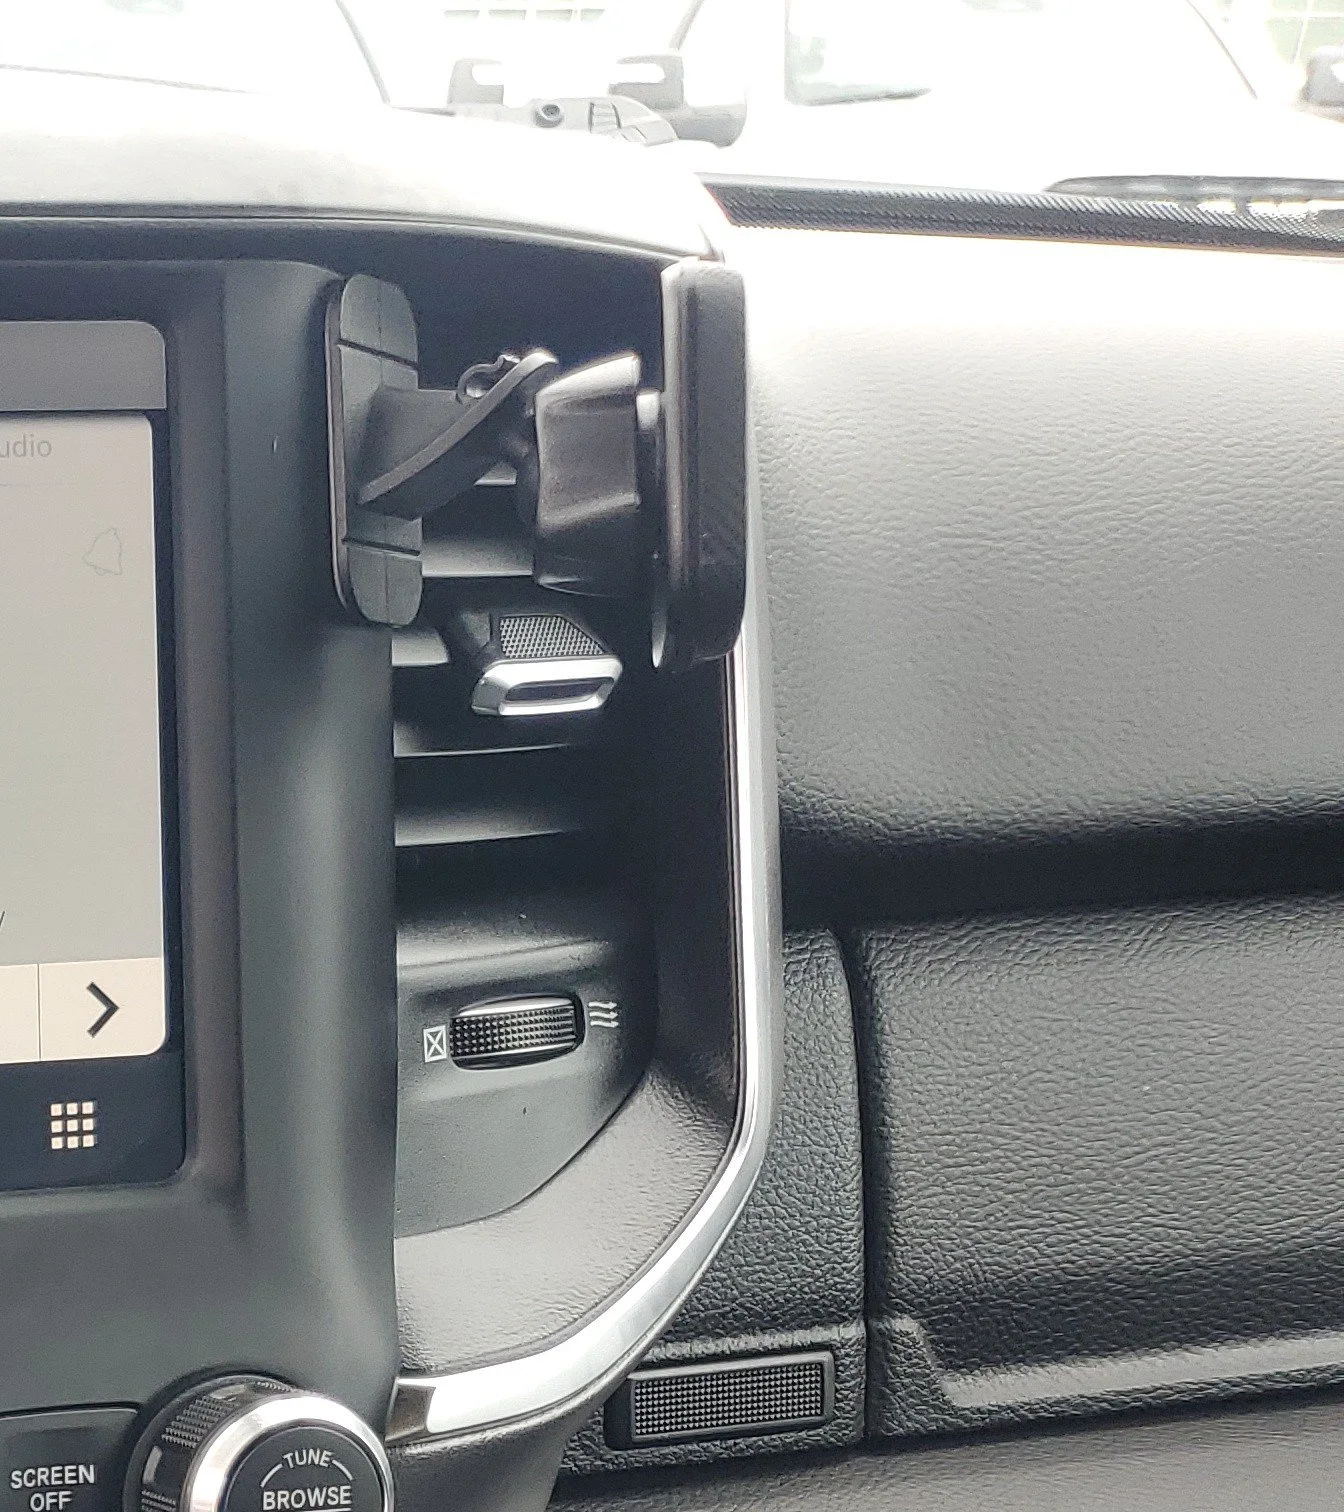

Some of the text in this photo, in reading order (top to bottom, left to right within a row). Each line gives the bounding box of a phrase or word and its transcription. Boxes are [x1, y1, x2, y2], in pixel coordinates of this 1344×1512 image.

[282, 1447, 334, 1471] TUNE
[10, 1463, 96, 1490] SCREEN
[29, 1490, 74, 1512] OFF
[261, 1485, 353, 1512] BROWSE
